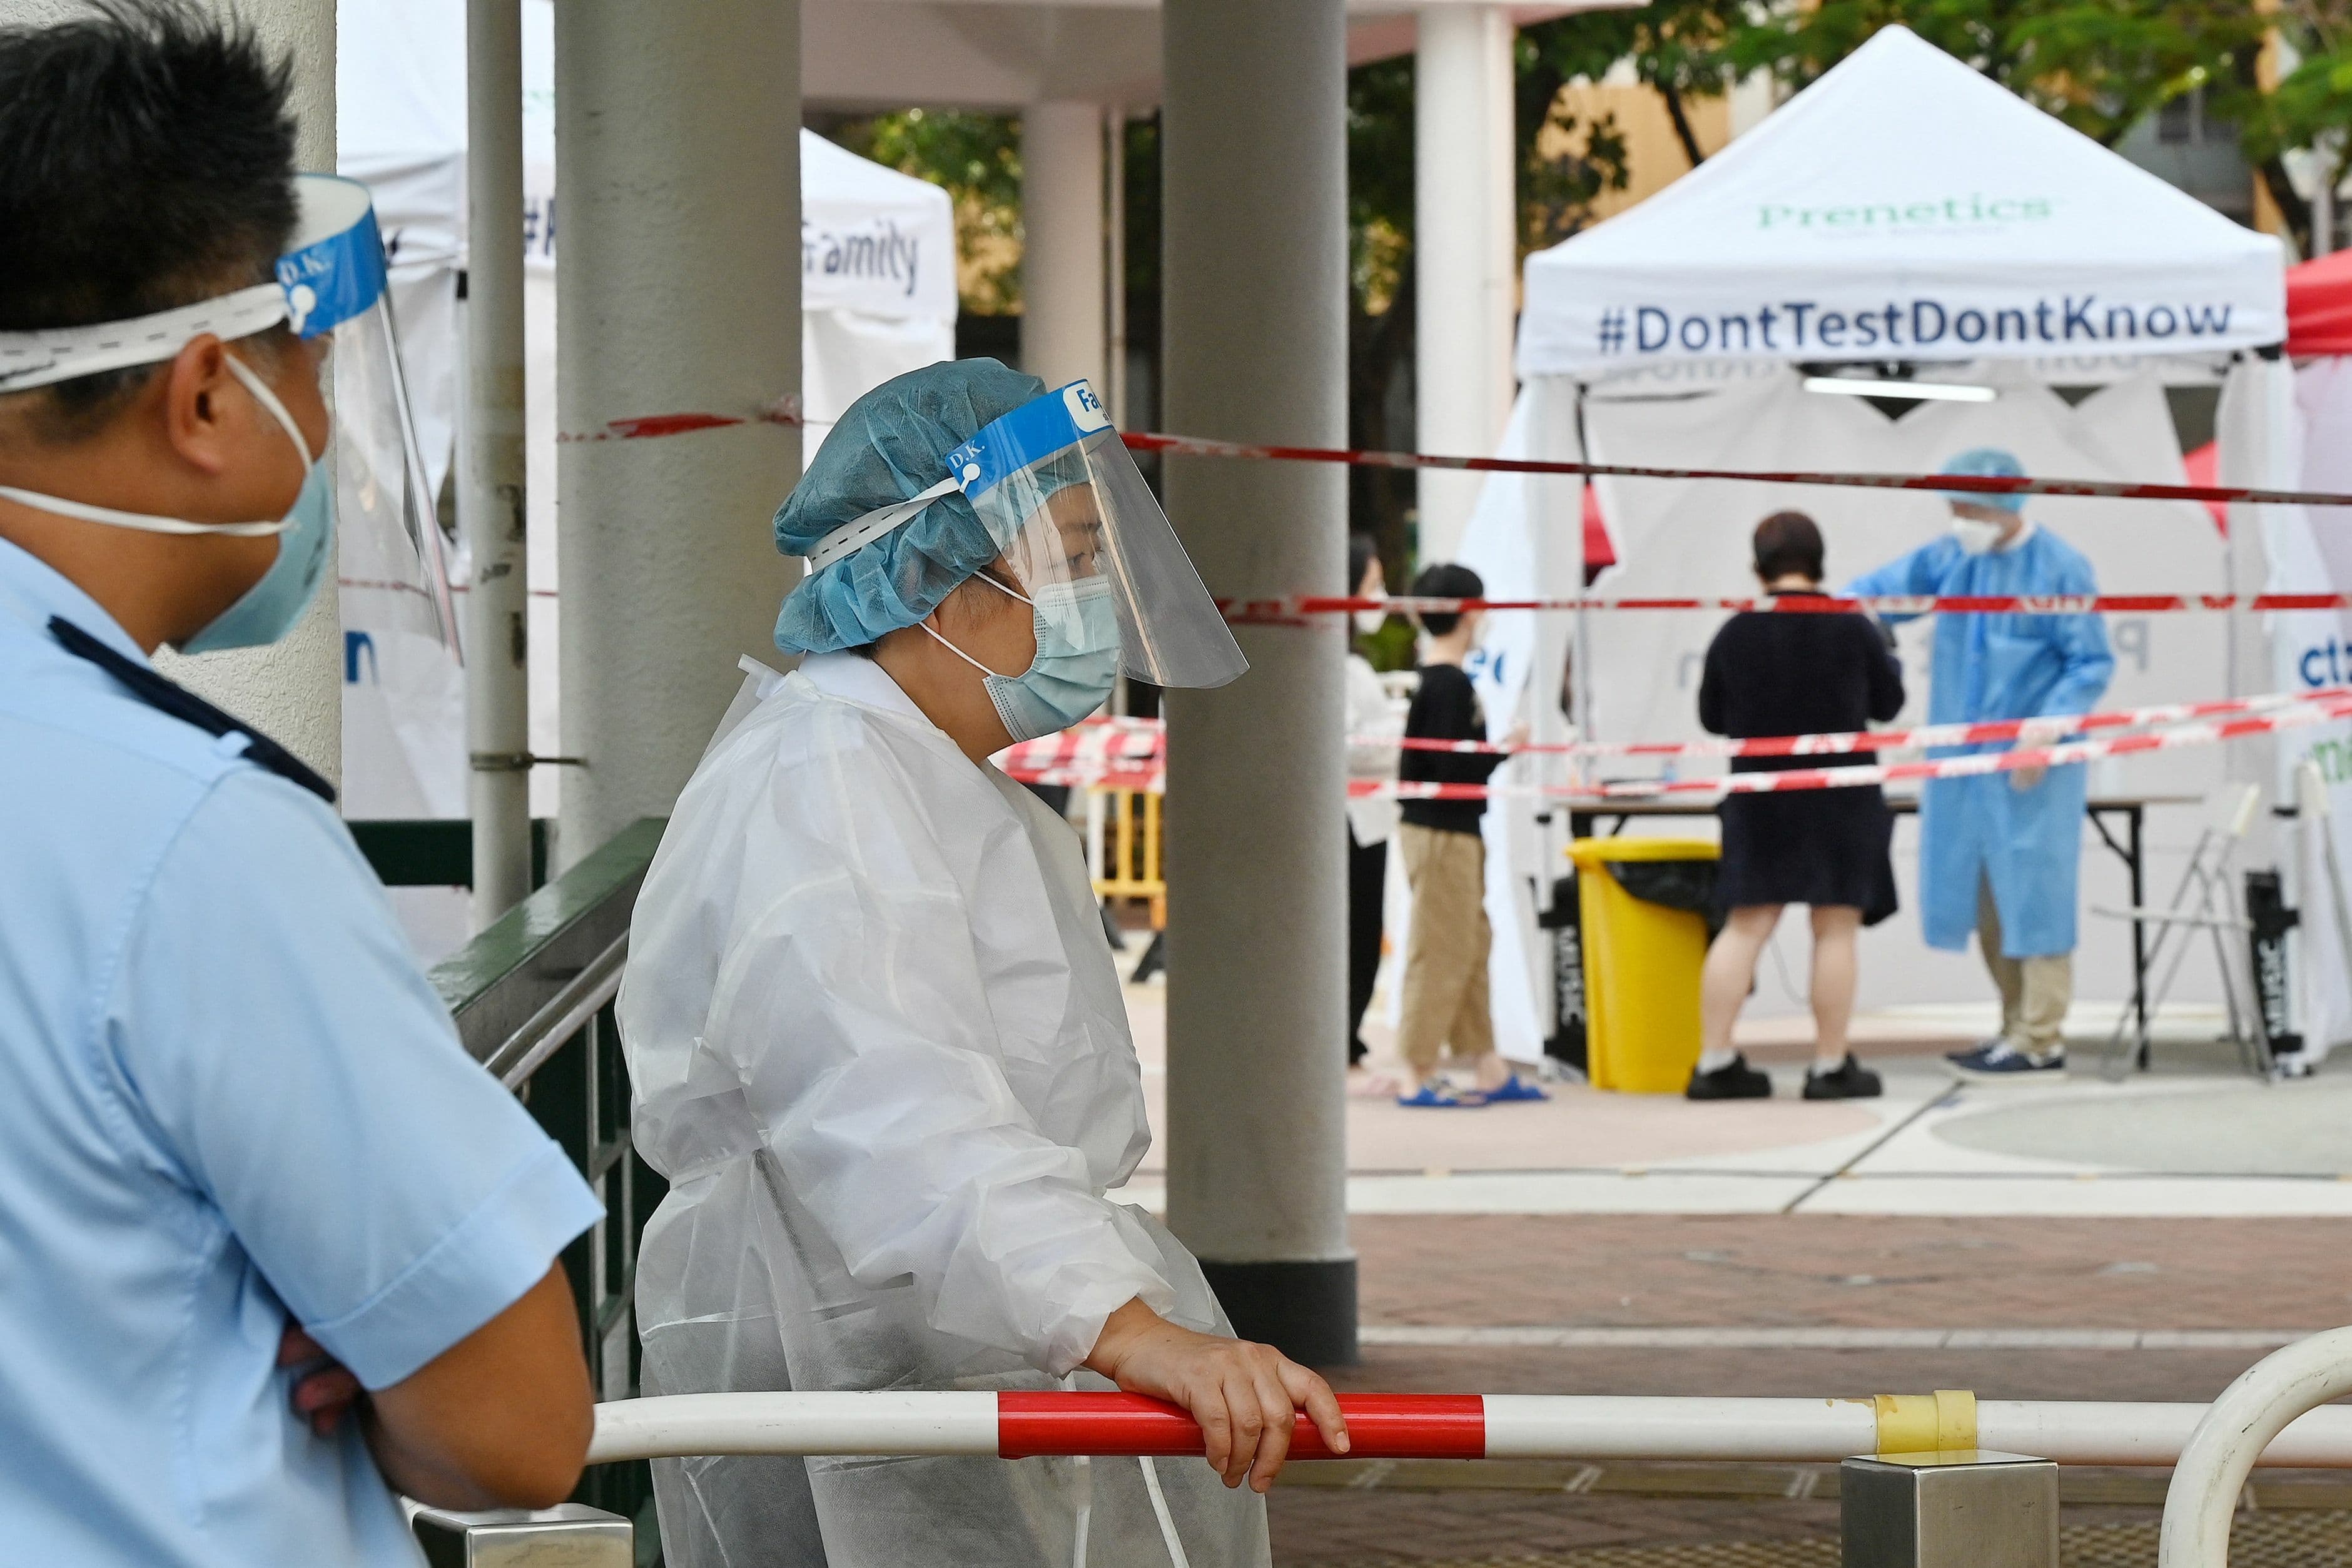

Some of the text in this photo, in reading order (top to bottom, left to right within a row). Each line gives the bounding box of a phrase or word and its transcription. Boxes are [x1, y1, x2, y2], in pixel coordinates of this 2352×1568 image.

[1757, 193, 2053, 230] Prenetics
[1598, 293, 2232, 354] #DontTestDontKnow
[948, 439, 986, 469] D.K.
